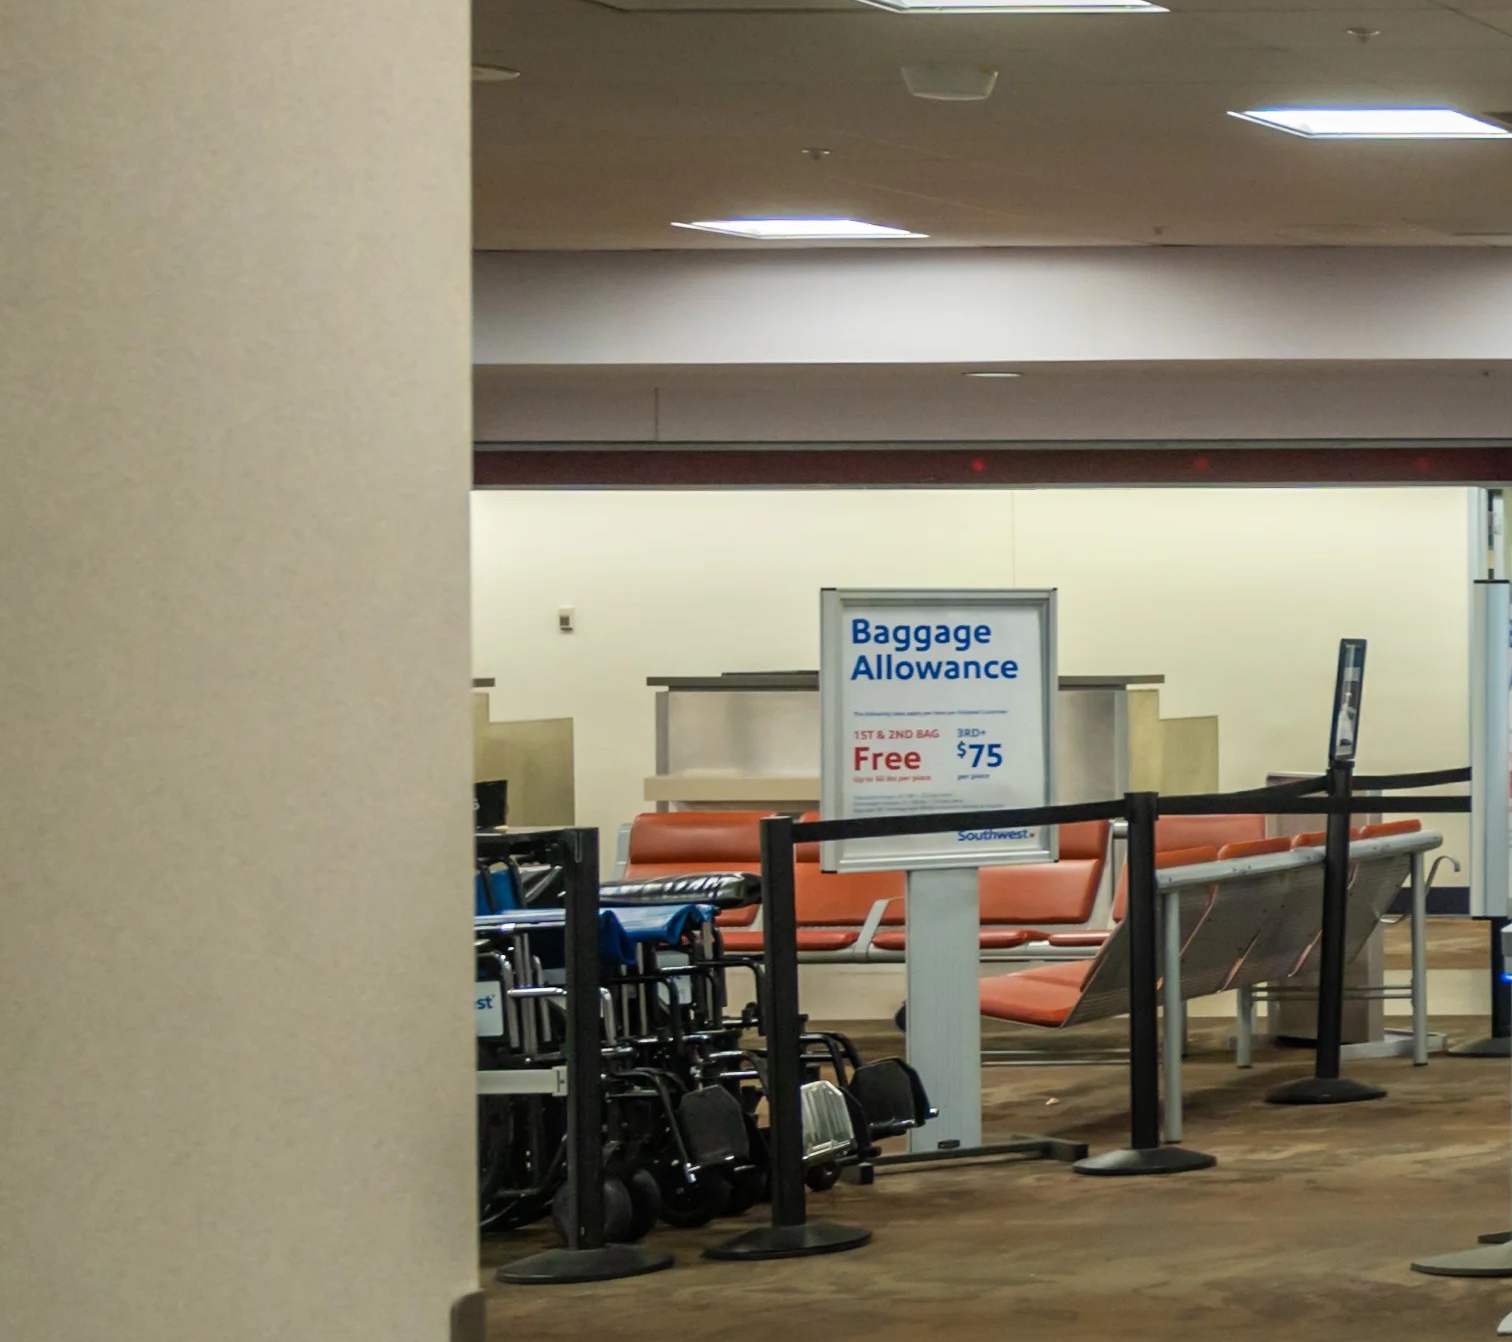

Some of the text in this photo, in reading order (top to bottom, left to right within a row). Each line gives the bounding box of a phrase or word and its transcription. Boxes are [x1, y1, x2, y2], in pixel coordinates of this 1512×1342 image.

[851, 618, 992, 652] Baggage
[850, 654, 1019, 681] Allowance
[854, 729, 940, 740] 1ST & 2ND BAG
[957, 728, 986, 738] 3RD+
[854, 746, 921, 771] Free
[957, 740, 1003, 768] $75
[957, 828, 1029, 842] Southwest
